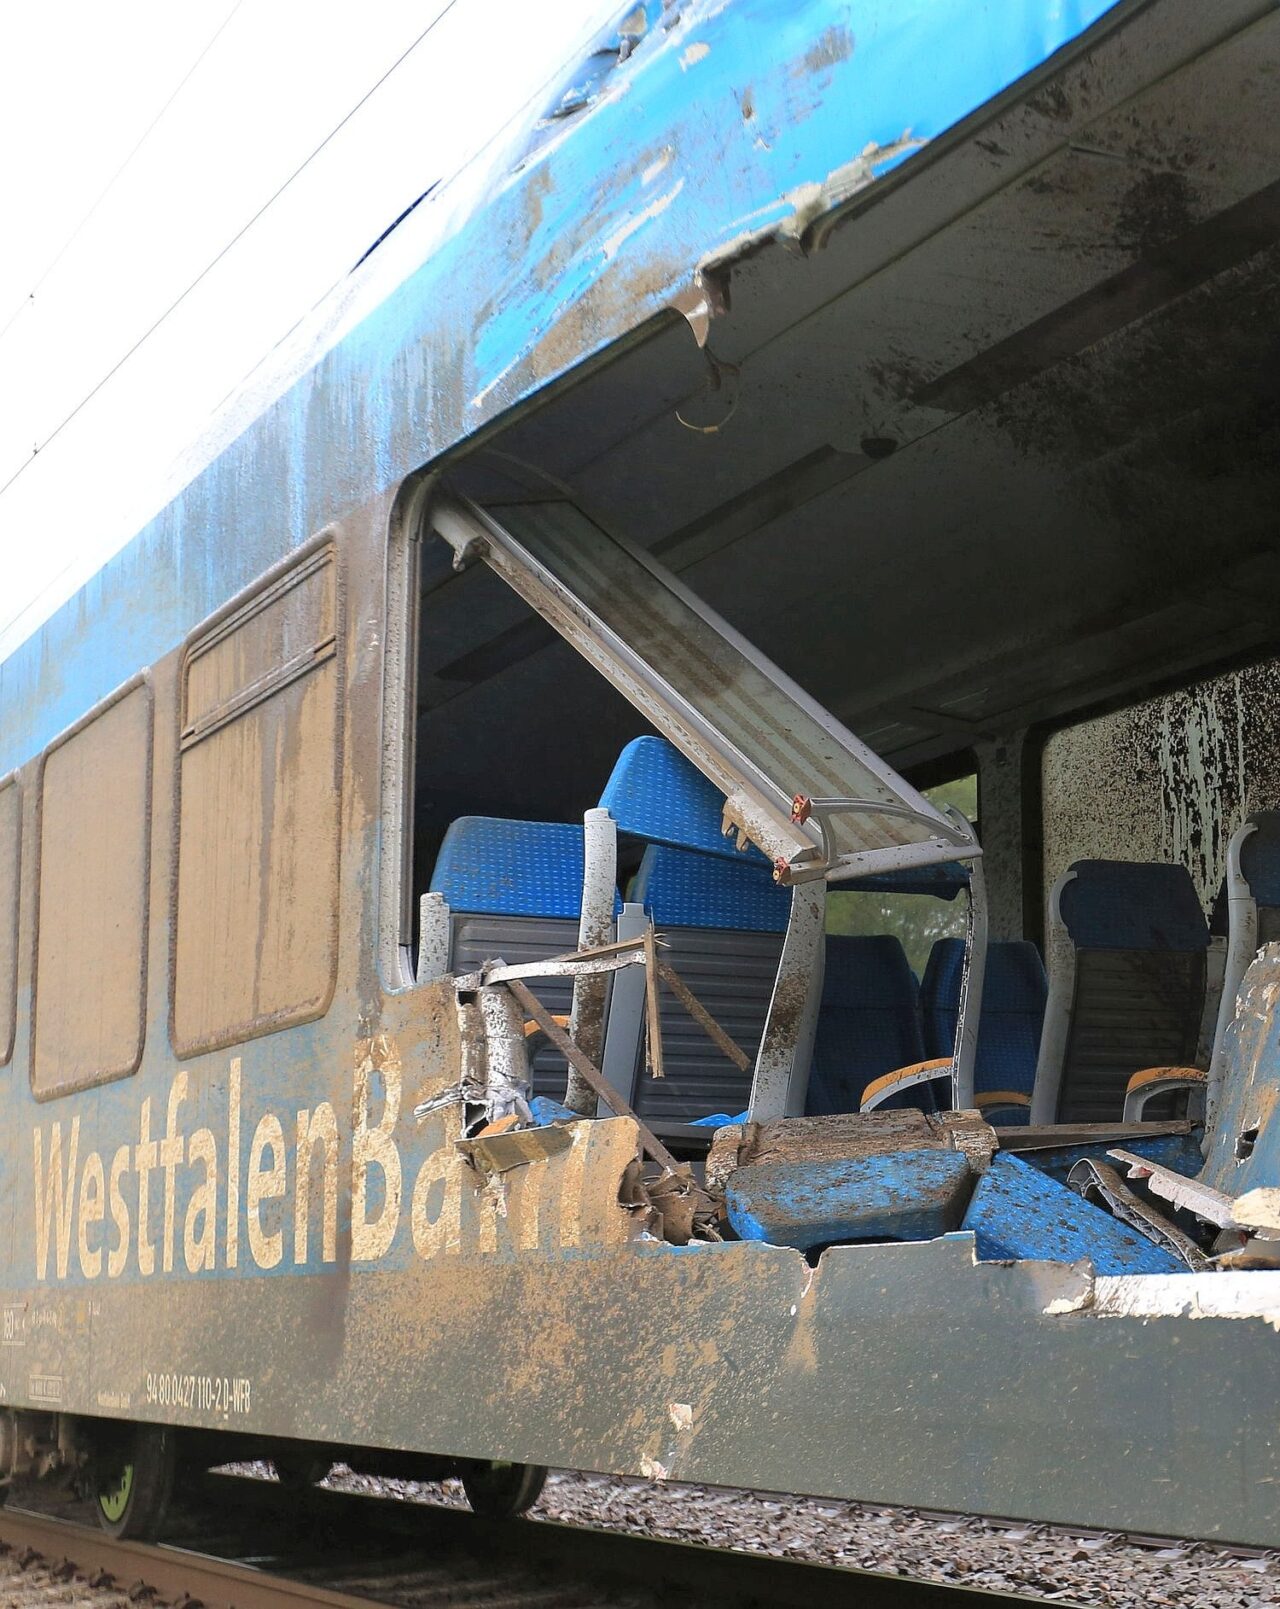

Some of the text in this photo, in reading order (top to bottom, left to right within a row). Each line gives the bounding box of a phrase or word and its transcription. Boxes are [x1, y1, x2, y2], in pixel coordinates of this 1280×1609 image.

[146, 1373, 158, 1404] 94
[159, 1373, 171, 1406] 80
[171, 1373, 195, 1409] 0427
[198, 1375, 222, 1412] 110-2
